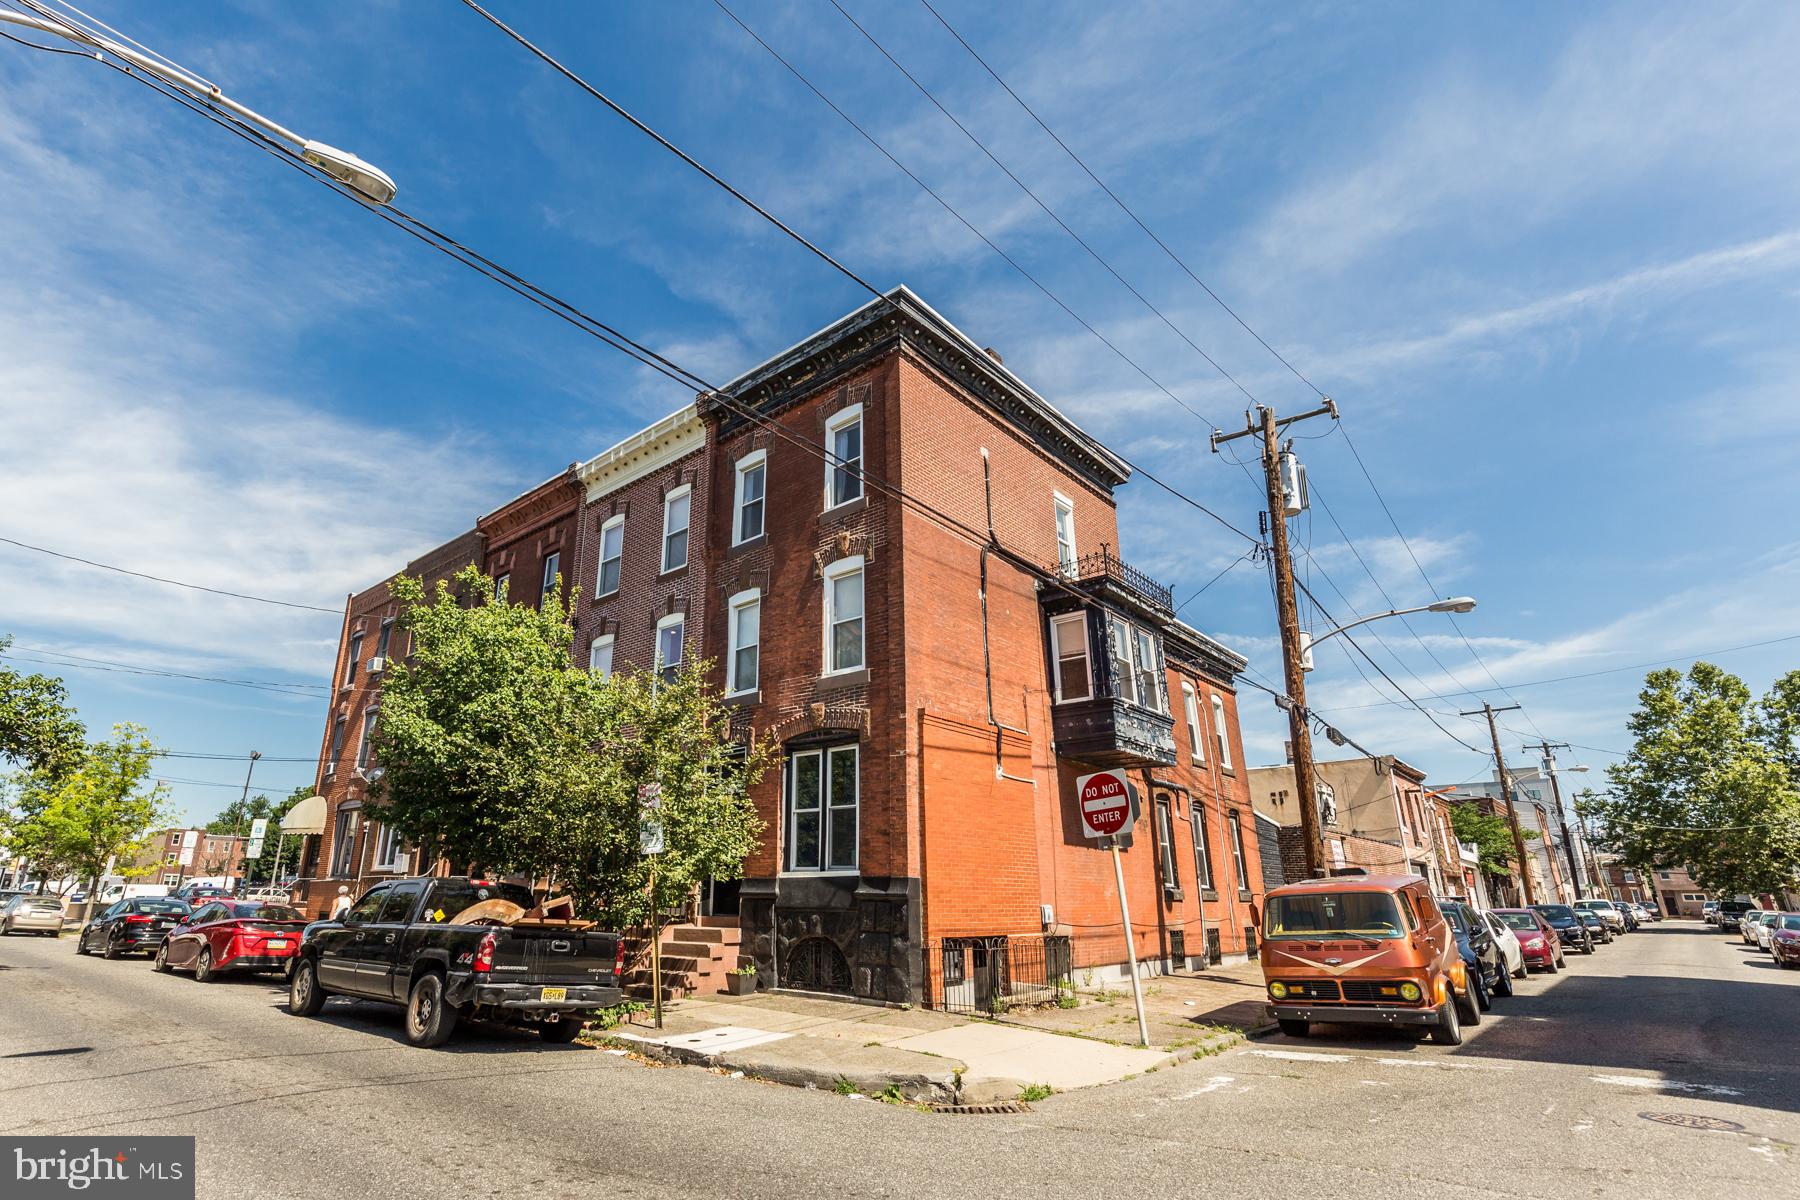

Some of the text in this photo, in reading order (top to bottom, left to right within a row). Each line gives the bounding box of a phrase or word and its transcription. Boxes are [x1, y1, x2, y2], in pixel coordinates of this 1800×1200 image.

[1086, 783, 1119, 798] DO NOT
[1093, 811, 1120, 824] ENTER
